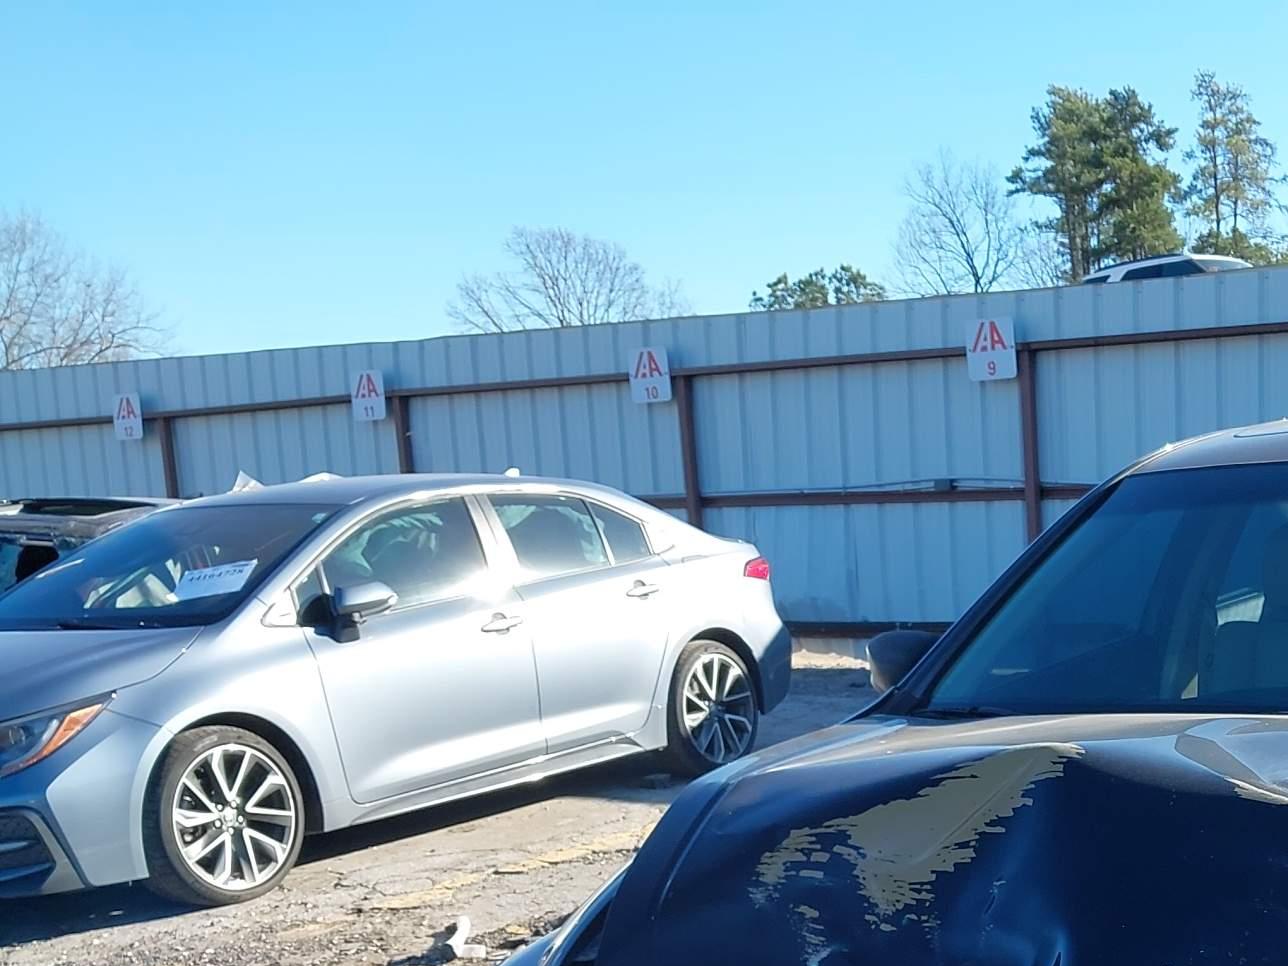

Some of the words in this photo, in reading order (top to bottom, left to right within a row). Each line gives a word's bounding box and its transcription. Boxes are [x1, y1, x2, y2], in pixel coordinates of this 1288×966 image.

[987, 361, 996, 376] 9
[645, 386, 658, 400] 10
[364, 405, 375, 418] 11
[124, 426, 134, 437] 12
